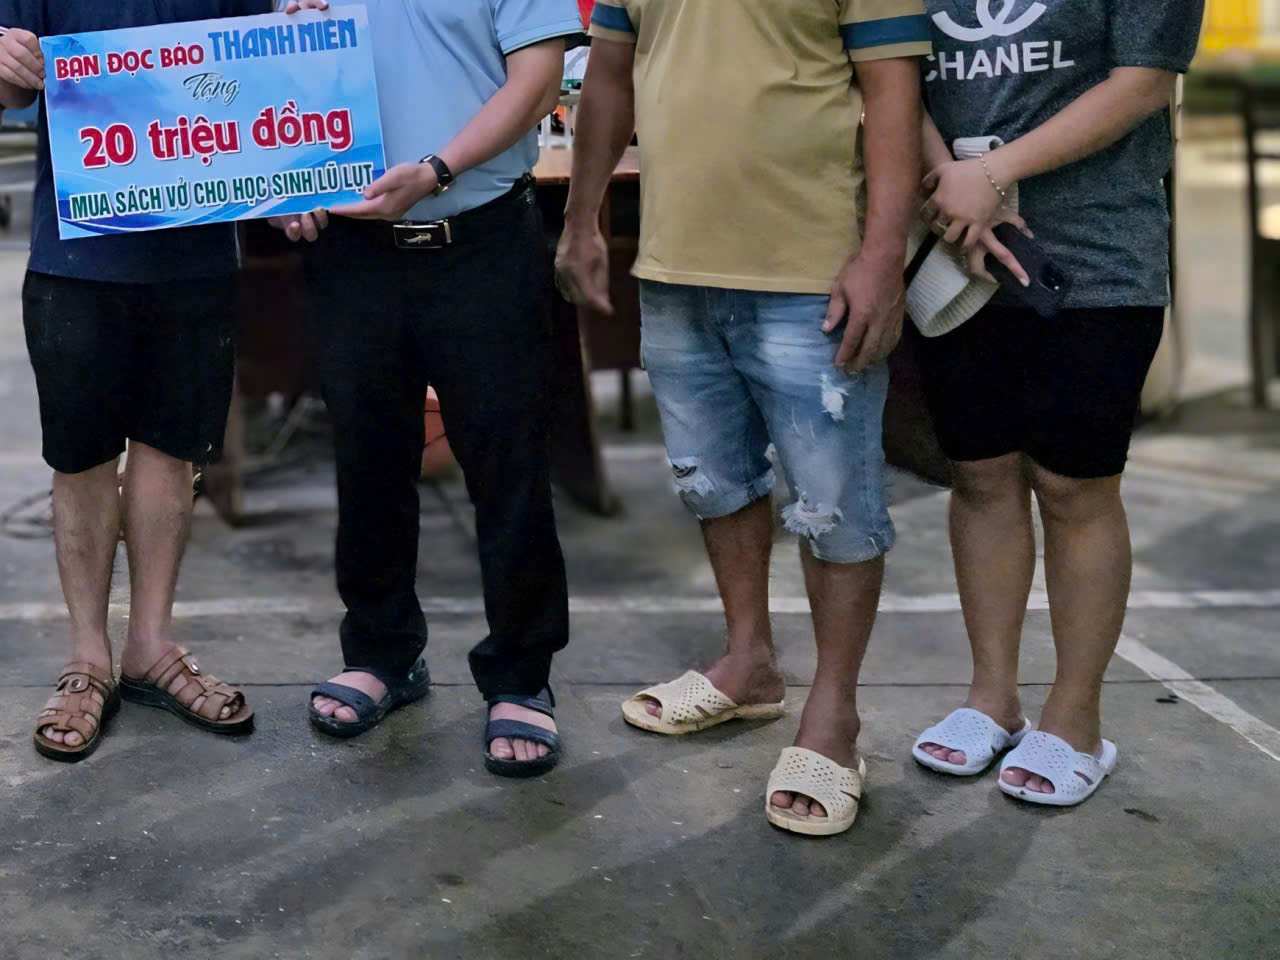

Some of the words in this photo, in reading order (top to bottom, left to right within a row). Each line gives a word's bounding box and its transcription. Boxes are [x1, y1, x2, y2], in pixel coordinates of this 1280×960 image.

[55, 54, 100, 81] BẠN
[107, 49, 154, 76] ĐỌC
[160, 42, 205, 68] BÁO
[208, 24, 296, 62] THANH
[80, 123, 135, 168] 20
[148, 116, 240, 165] triệu
[251, 101, 353, 150] đồng
[71, 192, 112, 220] MUA
[115, 184, 162, 214] SÁCH
[166, 177, 188, 207] VỞ
[193, 179, 228, 205] CHO
[232, 176, 267, 205] HỌC
[272, 169, 313, 196] SINH
[317, 162, 338, 191] LŨ
[343, 163, 372, 192] LỤT
